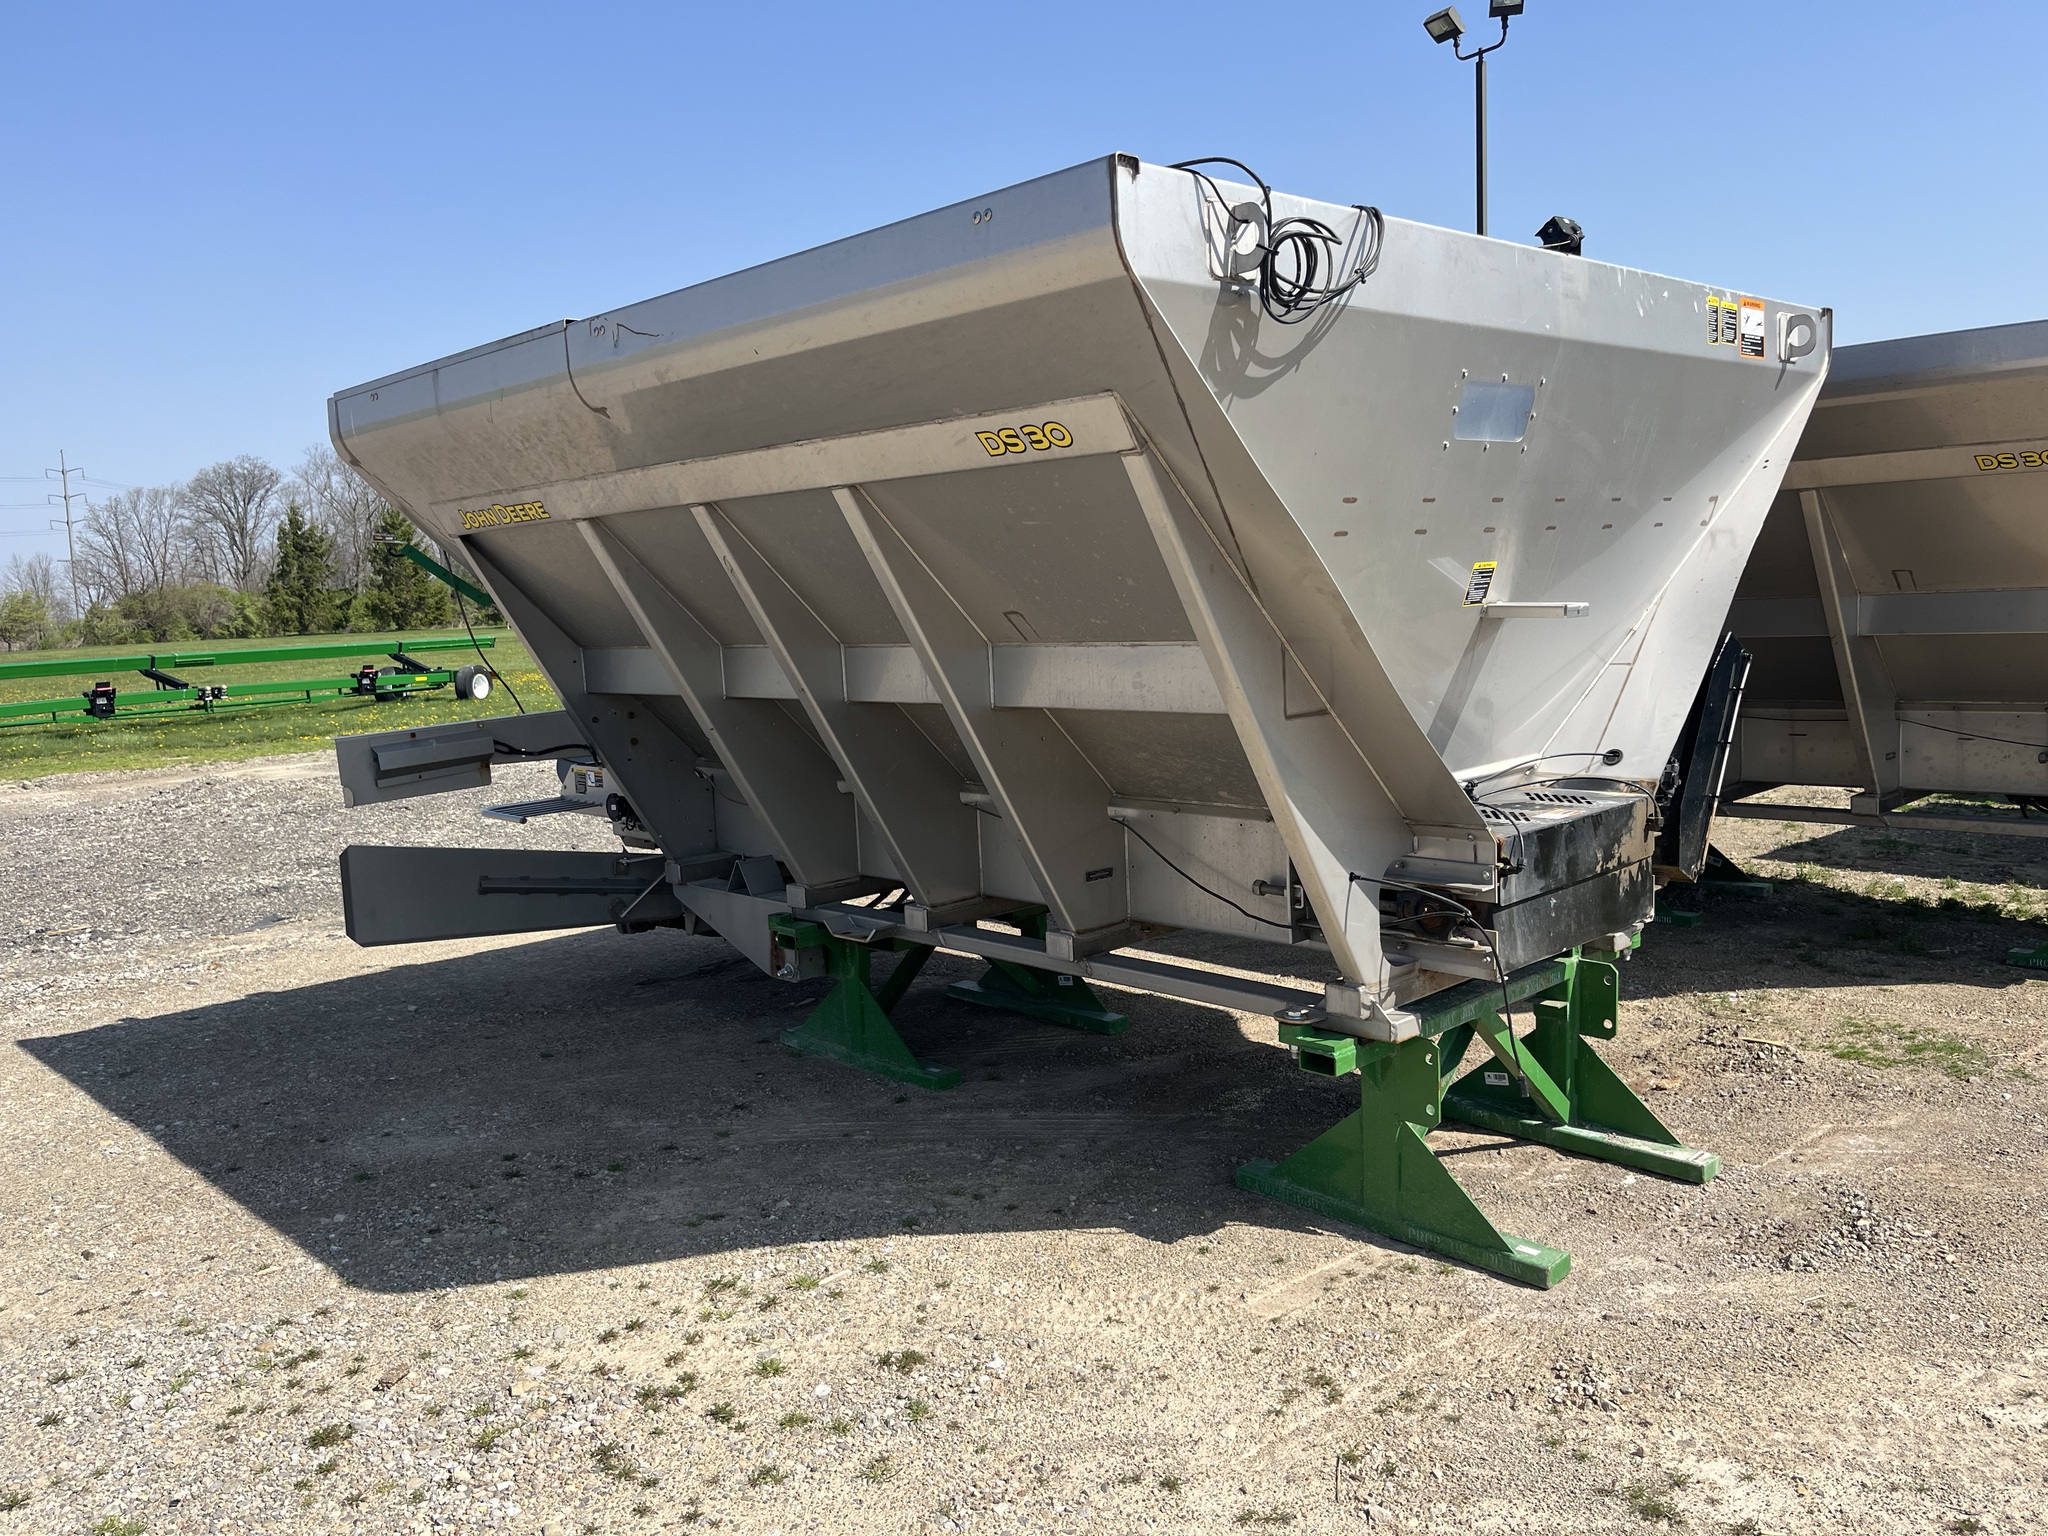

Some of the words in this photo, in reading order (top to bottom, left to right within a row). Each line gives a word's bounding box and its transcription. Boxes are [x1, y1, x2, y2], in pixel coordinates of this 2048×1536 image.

[974, 427, 1027, 457] DS
[1019, 421, 1074, 451] 30
[1974, 452, 2019, 471] DS
[2019, 450, 2048, 467] 3
[458, 508, 501, 530] JOHN
[492, 500, 551, 525] DEERE
